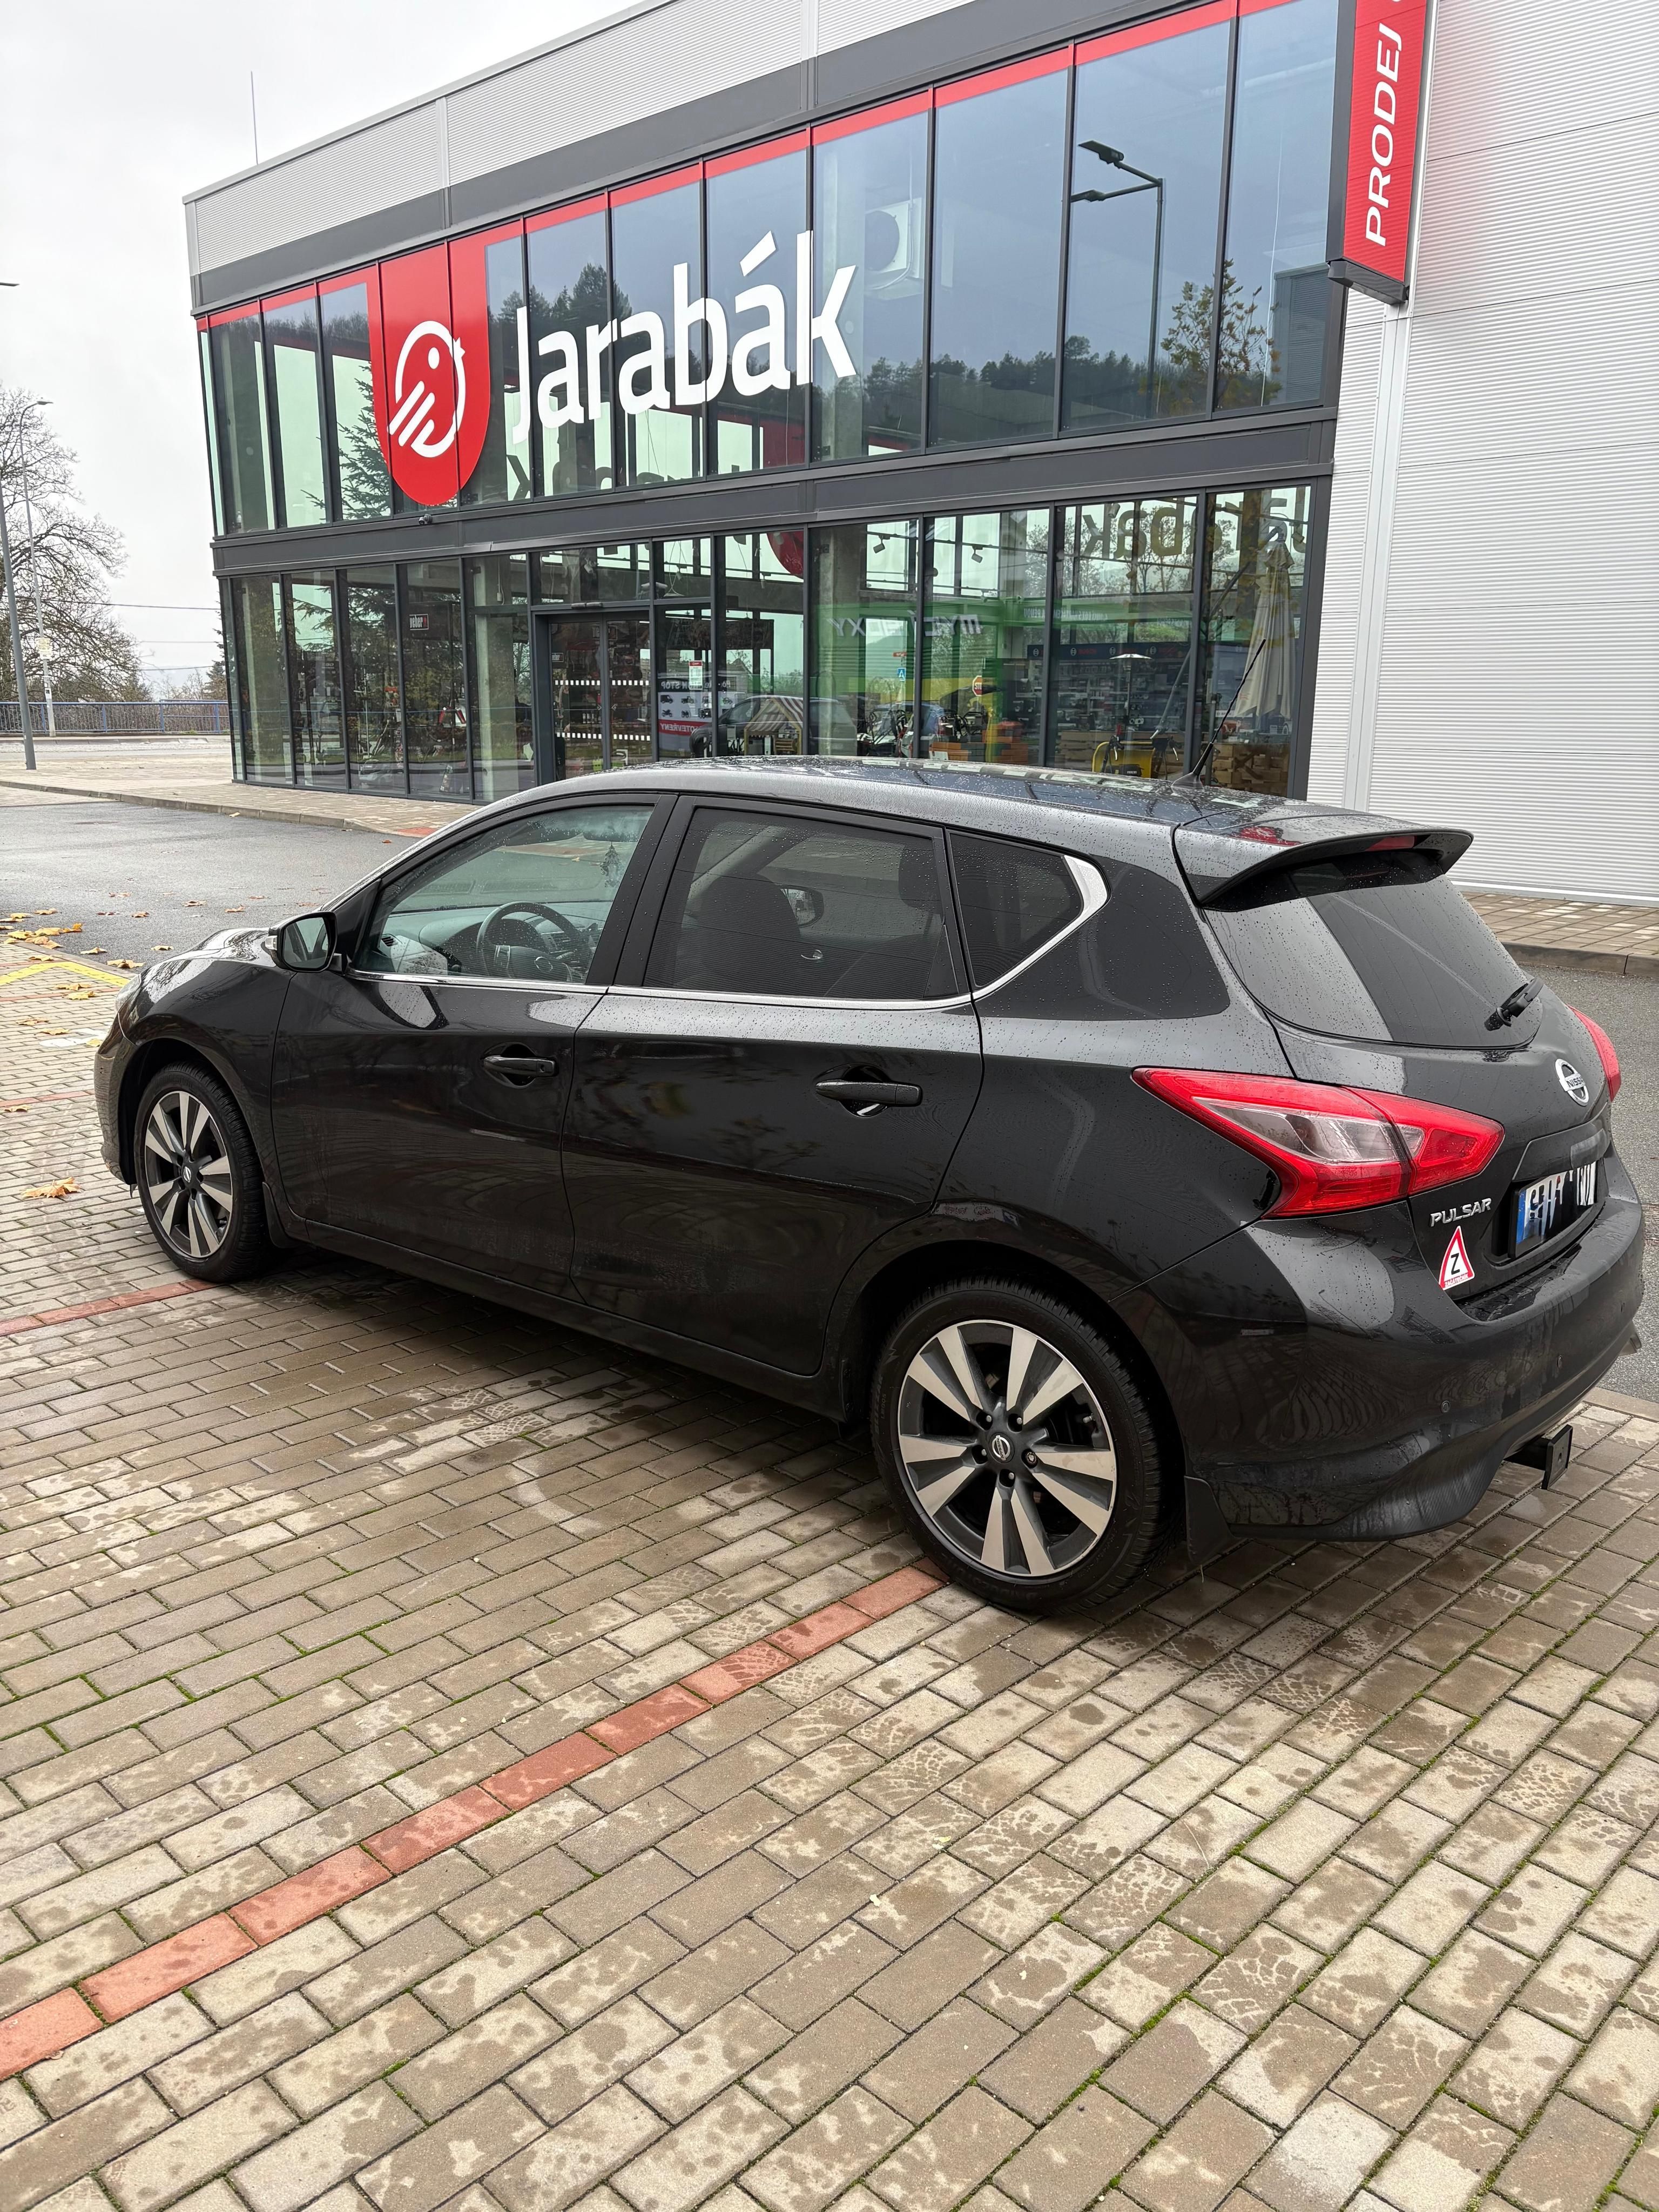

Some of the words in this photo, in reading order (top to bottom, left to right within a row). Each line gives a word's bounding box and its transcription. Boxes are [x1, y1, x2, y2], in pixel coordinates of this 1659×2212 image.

[1365, 23, 1402, 247] PRODEJ
[512, 231, 857, 444] Jarabák
[1566, 1076, 1583, 1088] NISS
[1429, 1198, 1492, 1227] PULSAR
[1451, 1253, 1460, 1275] Z
[996, 1438, 1004, 1458] NISSAN
